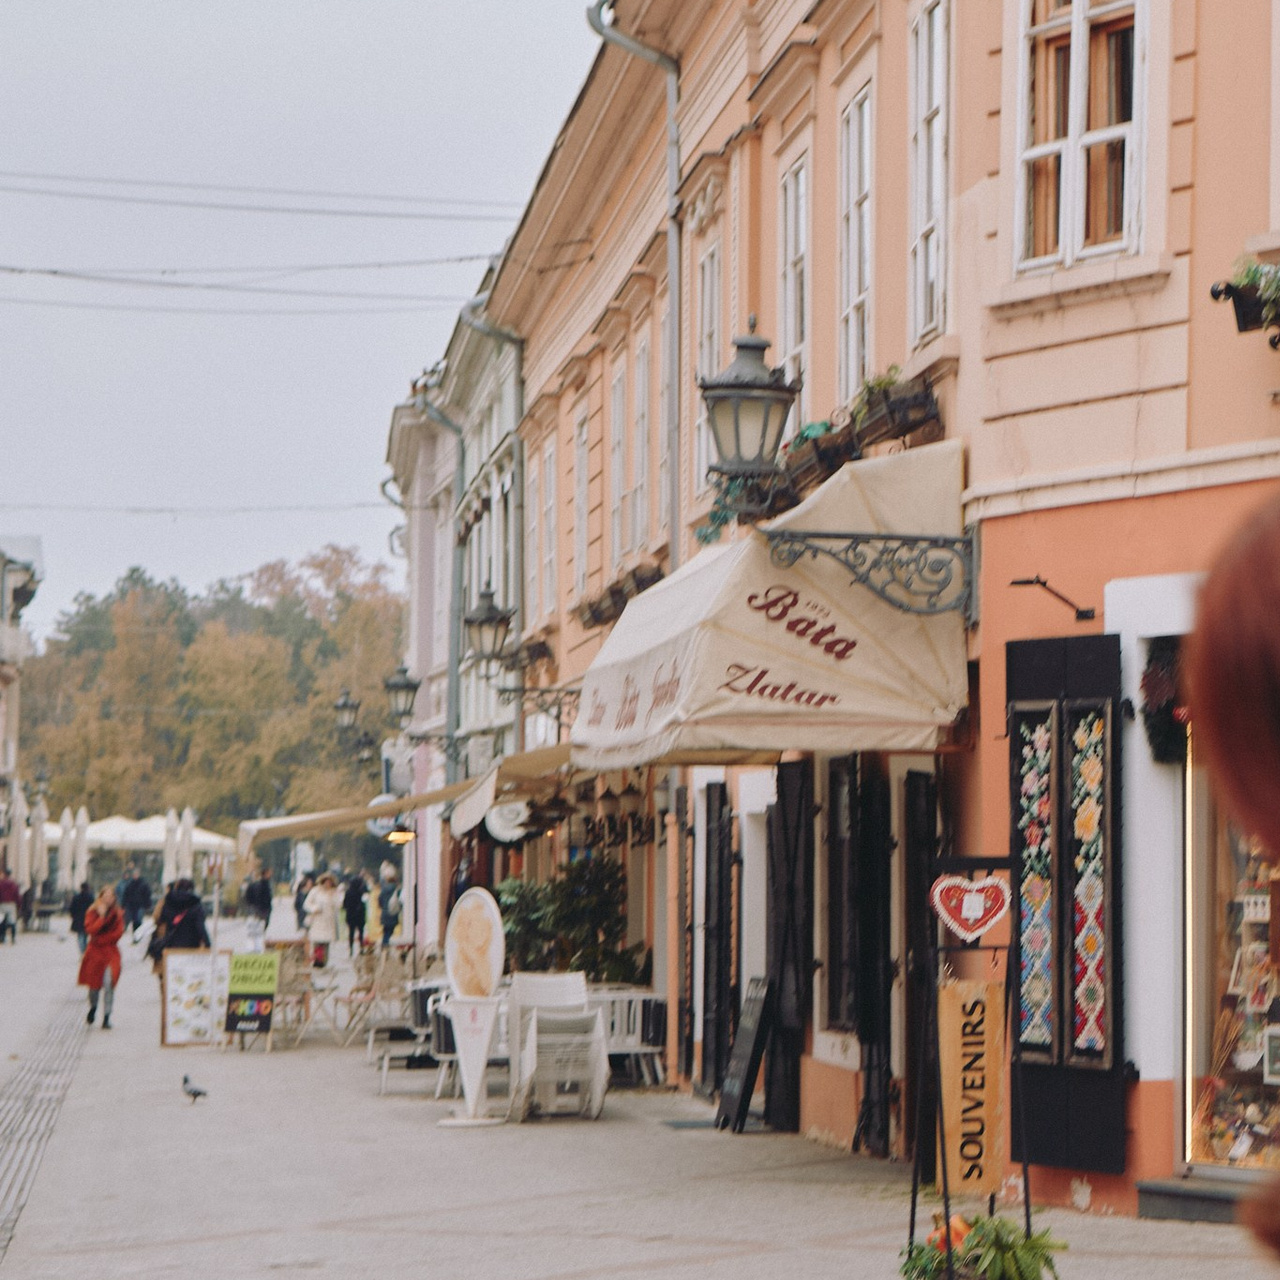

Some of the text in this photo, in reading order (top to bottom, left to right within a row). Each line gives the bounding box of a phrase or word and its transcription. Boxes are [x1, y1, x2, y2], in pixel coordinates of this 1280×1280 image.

[747, 584, 858, 661] Bata
[716, 662, 842, 708] Zlatar
[960, 998, 987, 1181] SOUVENIRS
